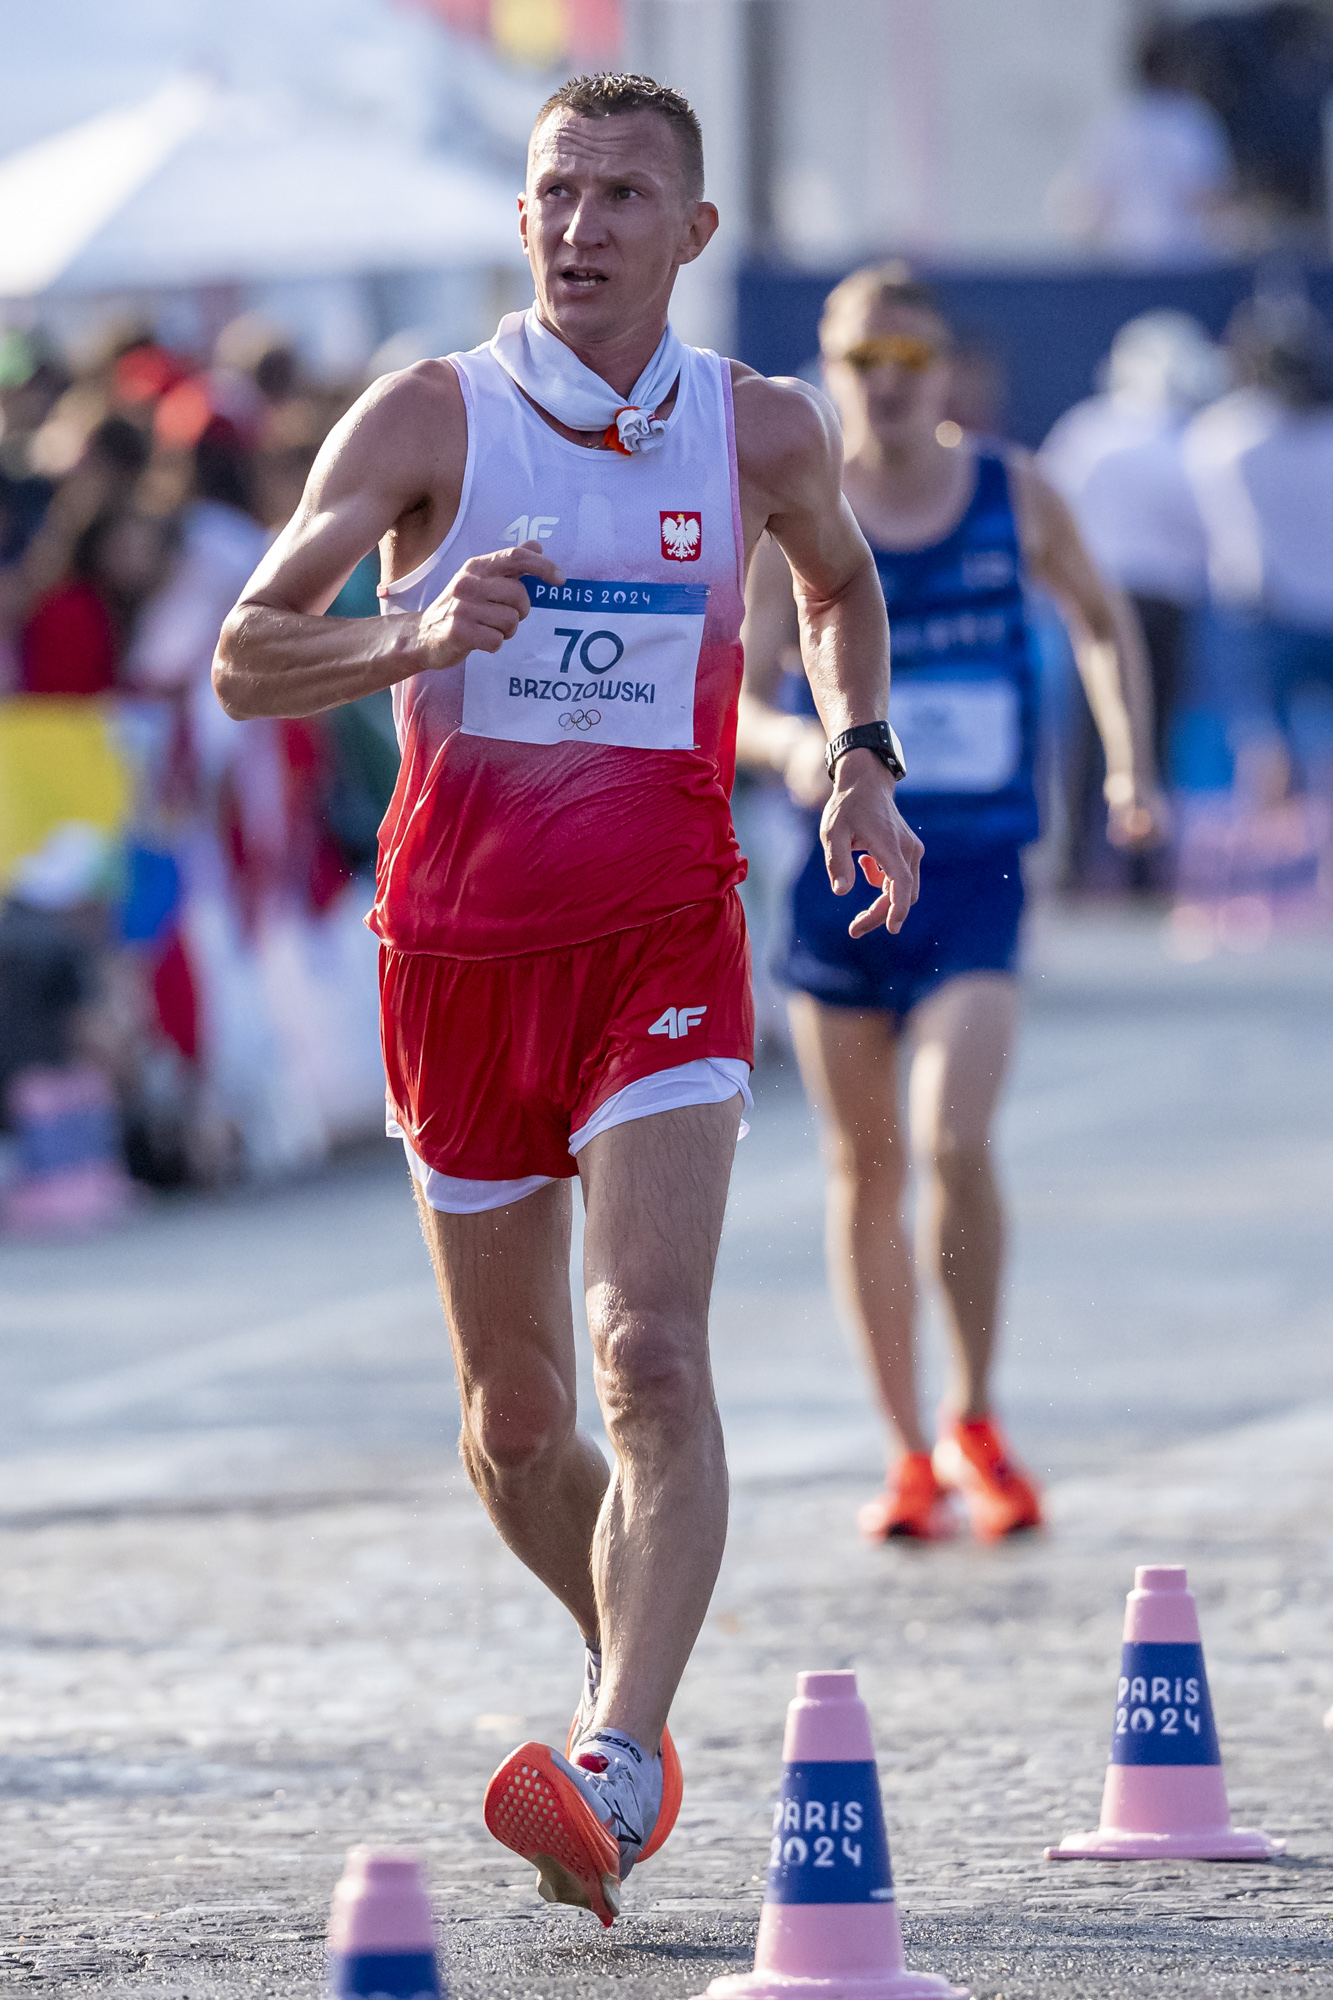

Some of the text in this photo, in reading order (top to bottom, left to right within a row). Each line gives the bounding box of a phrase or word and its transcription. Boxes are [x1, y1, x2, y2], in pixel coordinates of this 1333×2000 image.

[501, 514, 560, 548] 4F
[601, 590, 651, 605] 2024
[553, 627, 625, 675] 70
[508, 676, 656, 704] BRZOZOWSKI
[647, 1005, 708, 1039] 4F
[1116, 1707, 1200, 1735] 2024
